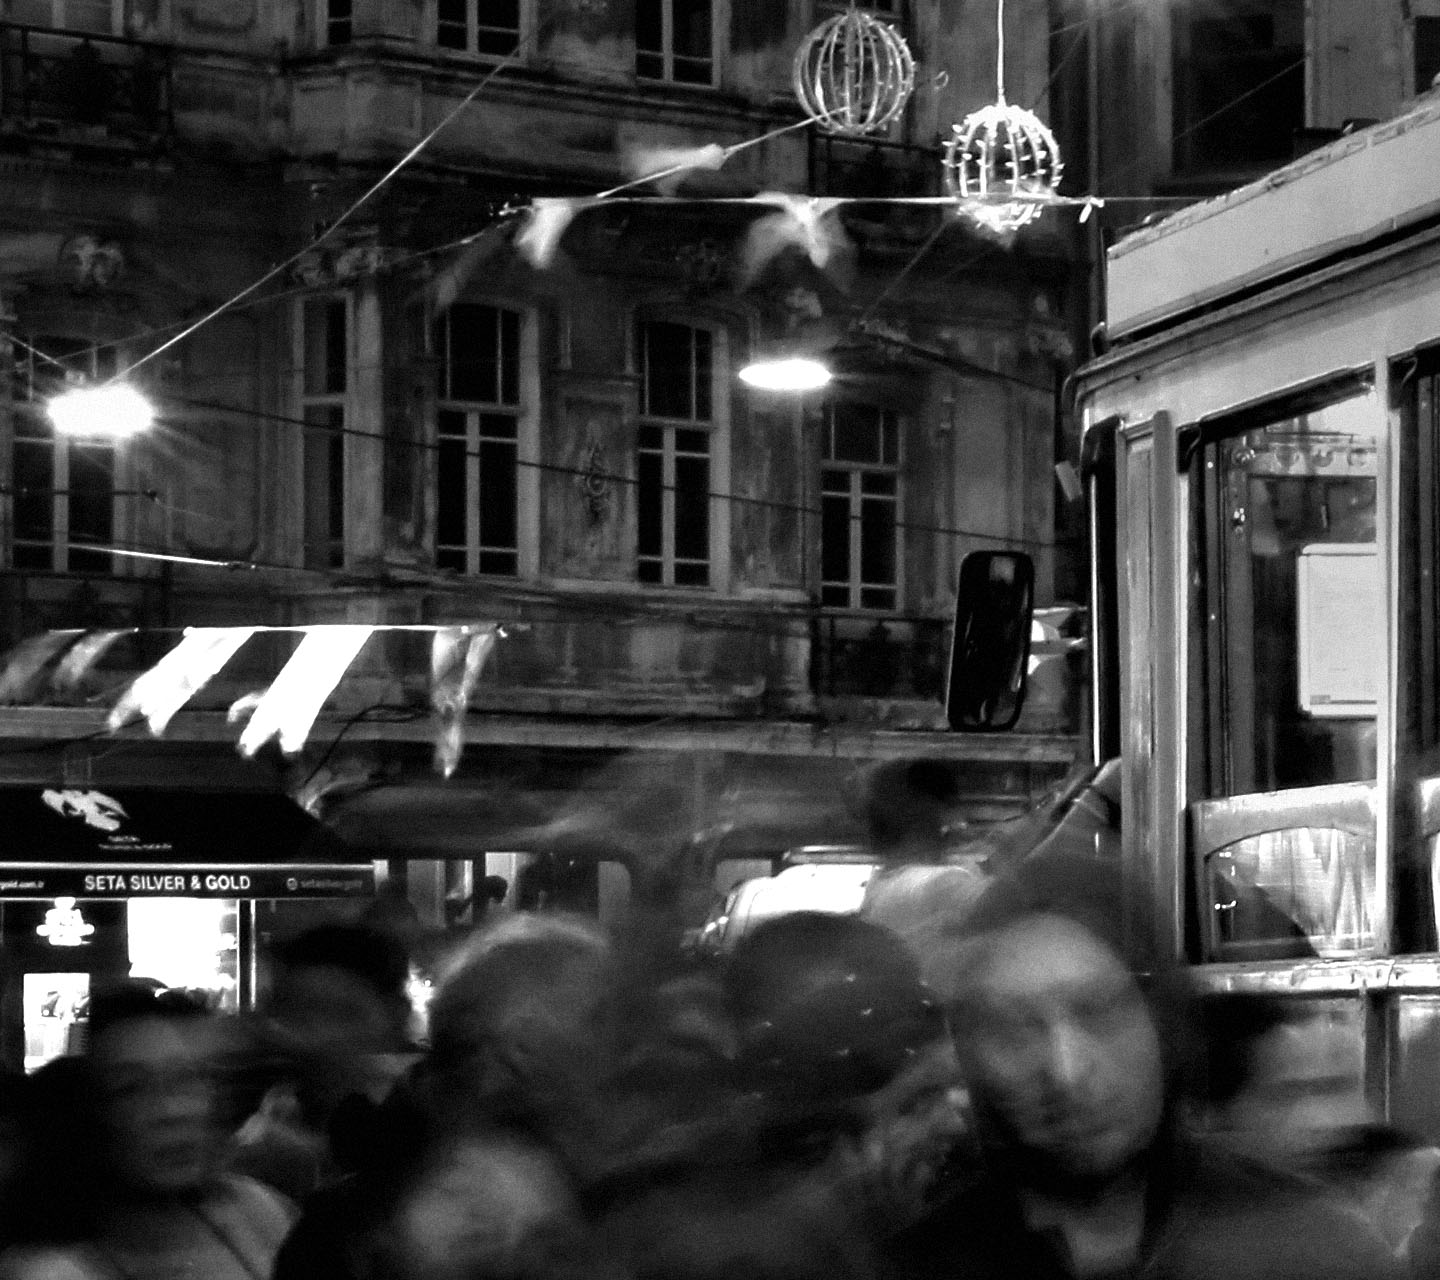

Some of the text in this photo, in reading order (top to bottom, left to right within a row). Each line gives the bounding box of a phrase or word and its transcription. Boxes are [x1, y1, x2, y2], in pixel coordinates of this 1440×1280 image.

[84, 874, 127, 891] SETA
[130, 874, 186, 891] SILVER
[190, 875, 201, 891] &
[205, 874, 251, 891] GOLD
